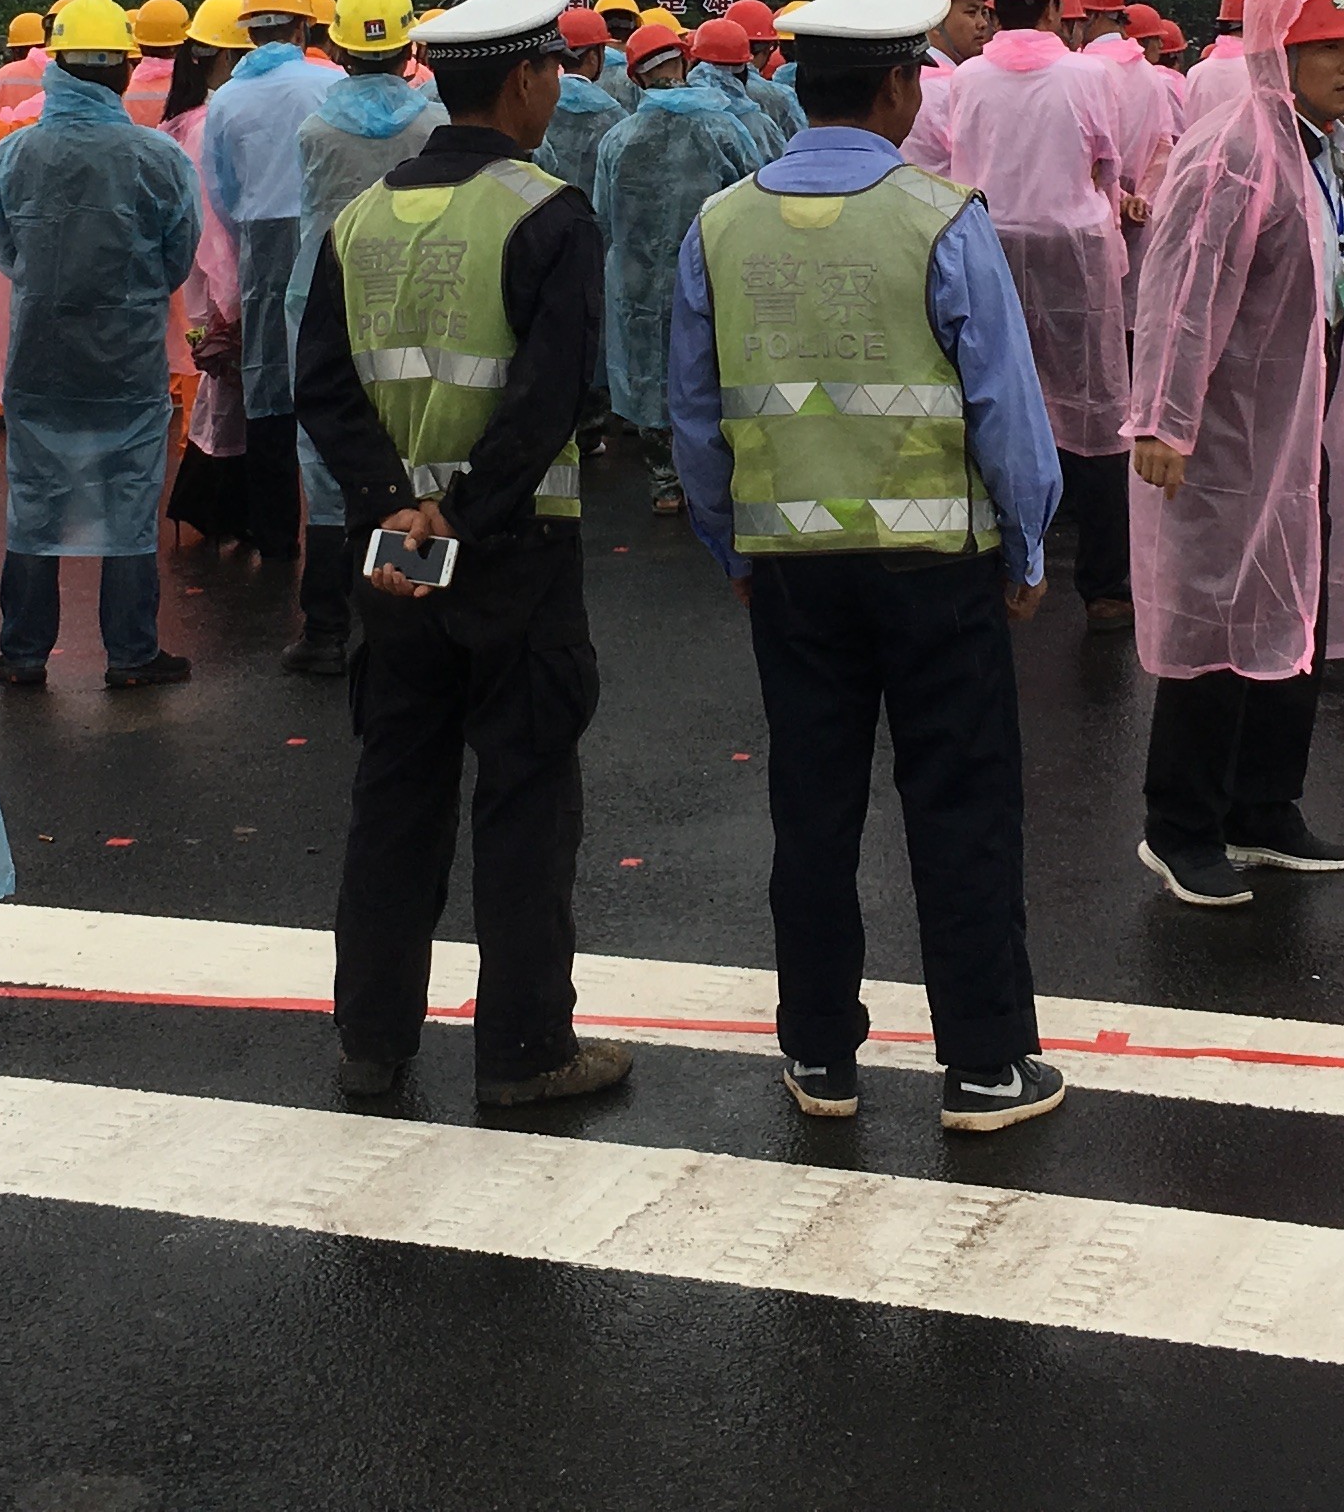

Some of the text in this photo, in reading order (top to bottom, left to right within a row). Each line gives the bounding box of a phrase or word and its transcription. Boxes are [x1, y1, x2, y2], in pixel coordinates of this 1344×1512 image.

[352, 235, 468, 307] 警察
[740, 252, 879, 326] 警察
[357, 308, 468, 341] POLICE
[744, 332, 888, 363] POLICE
